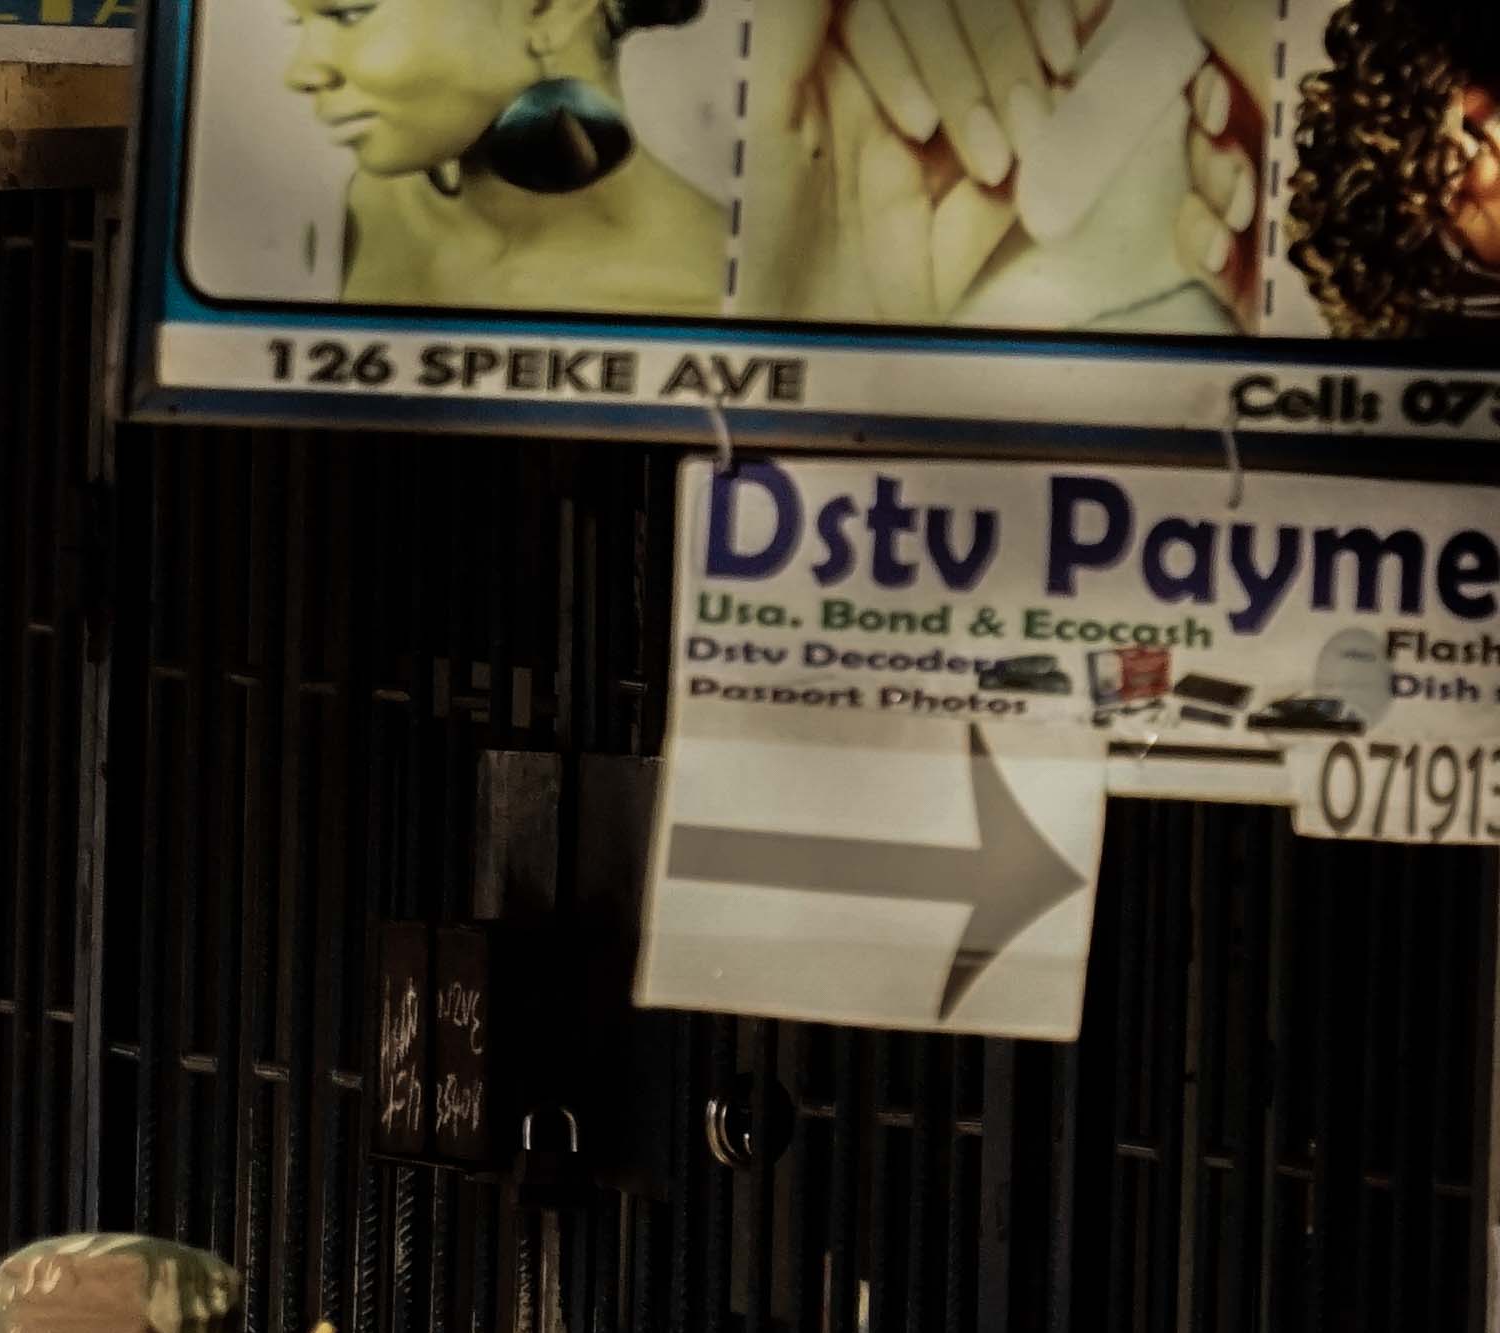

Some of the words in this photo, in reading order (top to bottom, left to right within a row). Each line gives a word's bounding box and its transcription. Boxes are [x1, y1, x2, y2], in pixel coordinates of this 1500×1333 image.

[267, 339, 395, 386] 126
[418, 344, 640, 395] SPEKE
[660, 353, 807, 403] AVE
[1402, 378, 1500, 428] 07
[705, 458, 1000, 592] Dstv
[1046, 474, 1500, 635] Payme
[697, 592, 801, 628] Usa.
[821, 598, 952, 637] Bond
[967, 606, 1007, 640] &
[1022, 608, 1214, 650] Ecocash
[687, 636, 789, 667] Dstv
[879, 685, 1028, 716] Photos
[1389, 673, 1481, 702] Dish
